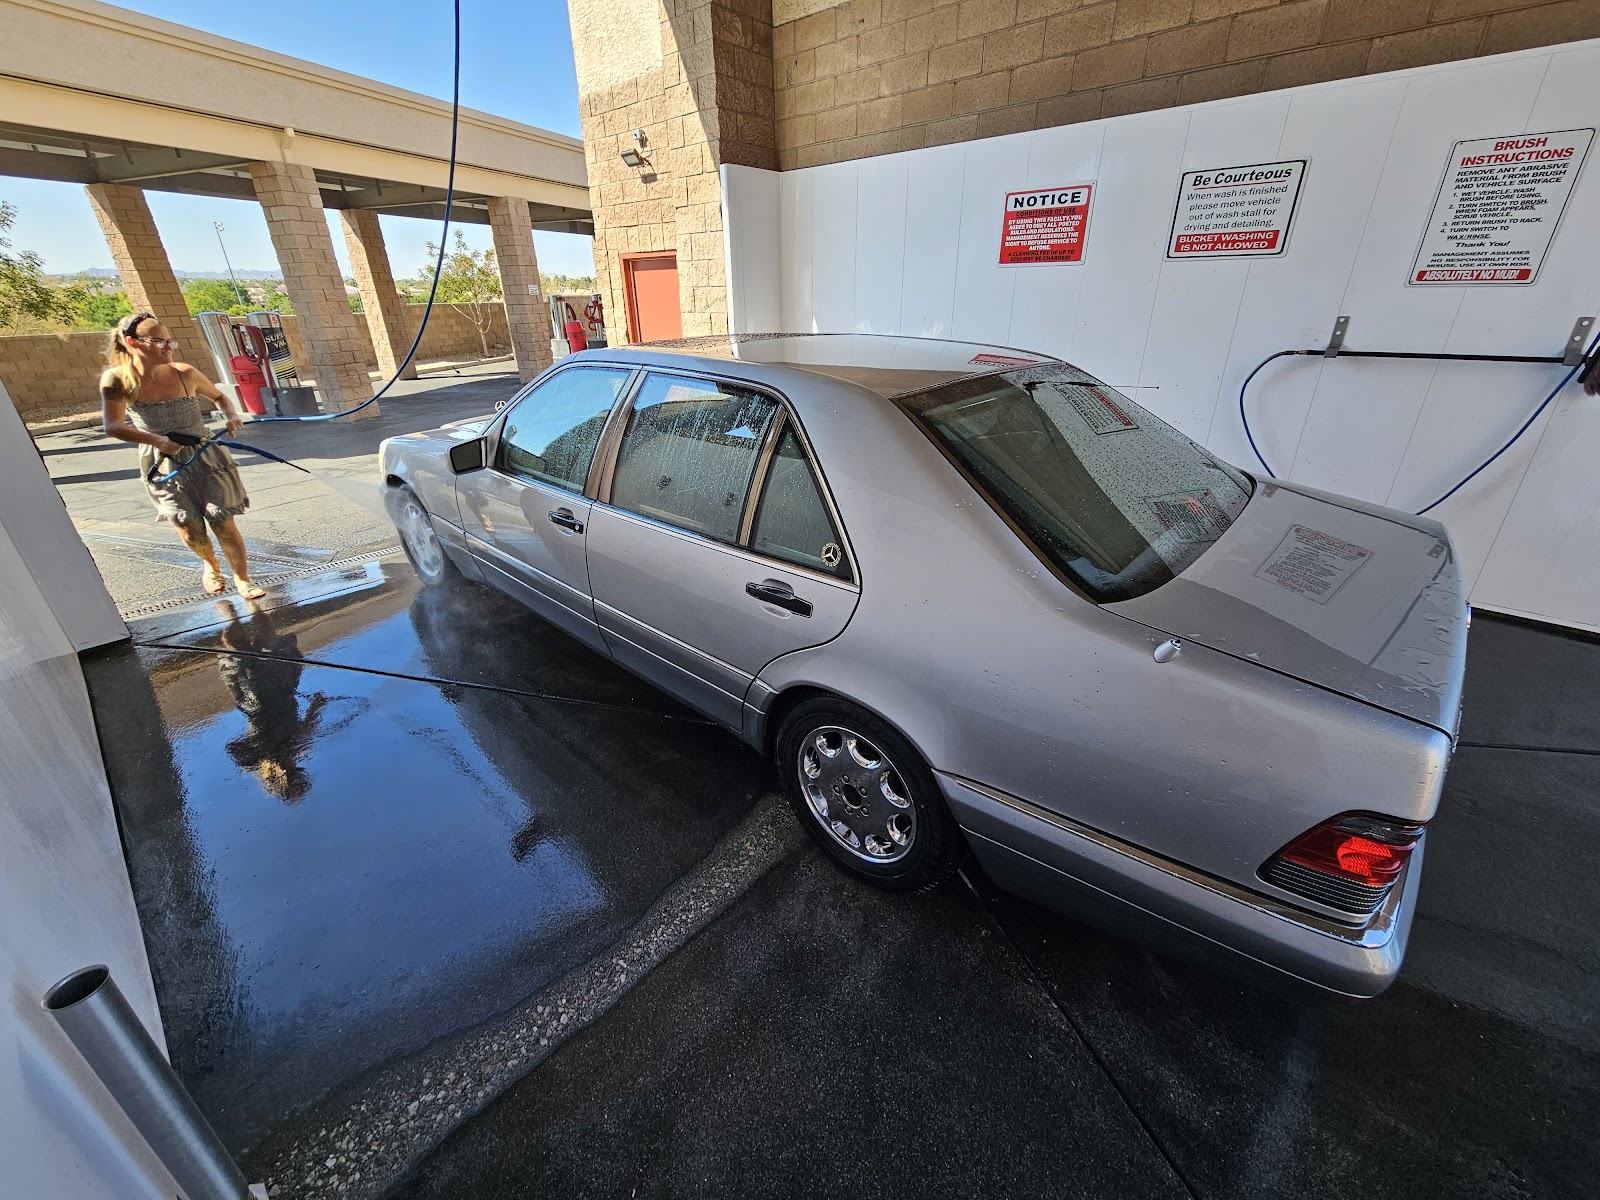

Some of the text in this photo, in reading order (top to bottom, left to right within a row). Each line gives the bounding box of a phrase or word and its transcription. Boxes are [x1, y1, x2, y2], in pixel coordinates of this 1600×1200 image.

[1494, 137, 1548, 151] BRUSH
[1460, 148, 1574, 166] INSTRUCTIONS
[1519, 163, 1569, 171] ABRASIVE
[1192, 168, 1292, 186] Be Courteous
[1455, 175, 1500, 183] MATERIAL
[1517, 177, 1562, 185] SURFACE
[1187, 192, 1212, 201] When
[1214, 190, 1237, 199] wash
[1248, 185, 1288, 196] finished
[1014, 192, 1081, 208] NOTICE
[1189, 197, 1282, 212] please move vehicle
[1204, 212, 1215, 220] of
[1216, 210, 1239, 219] wash
[1241, 208, 1261, 217] stall
[1263, 208, 1277, 216] for
[1184, 219, 1274, 232] drying and detailing.
[1180, 232, 1274, 243] BUCKET WASHING
[1214, 241, 1268, 250] ALLOWED
[1422, 270, 1520, 280] ABSOLUTELY NO MUD!
